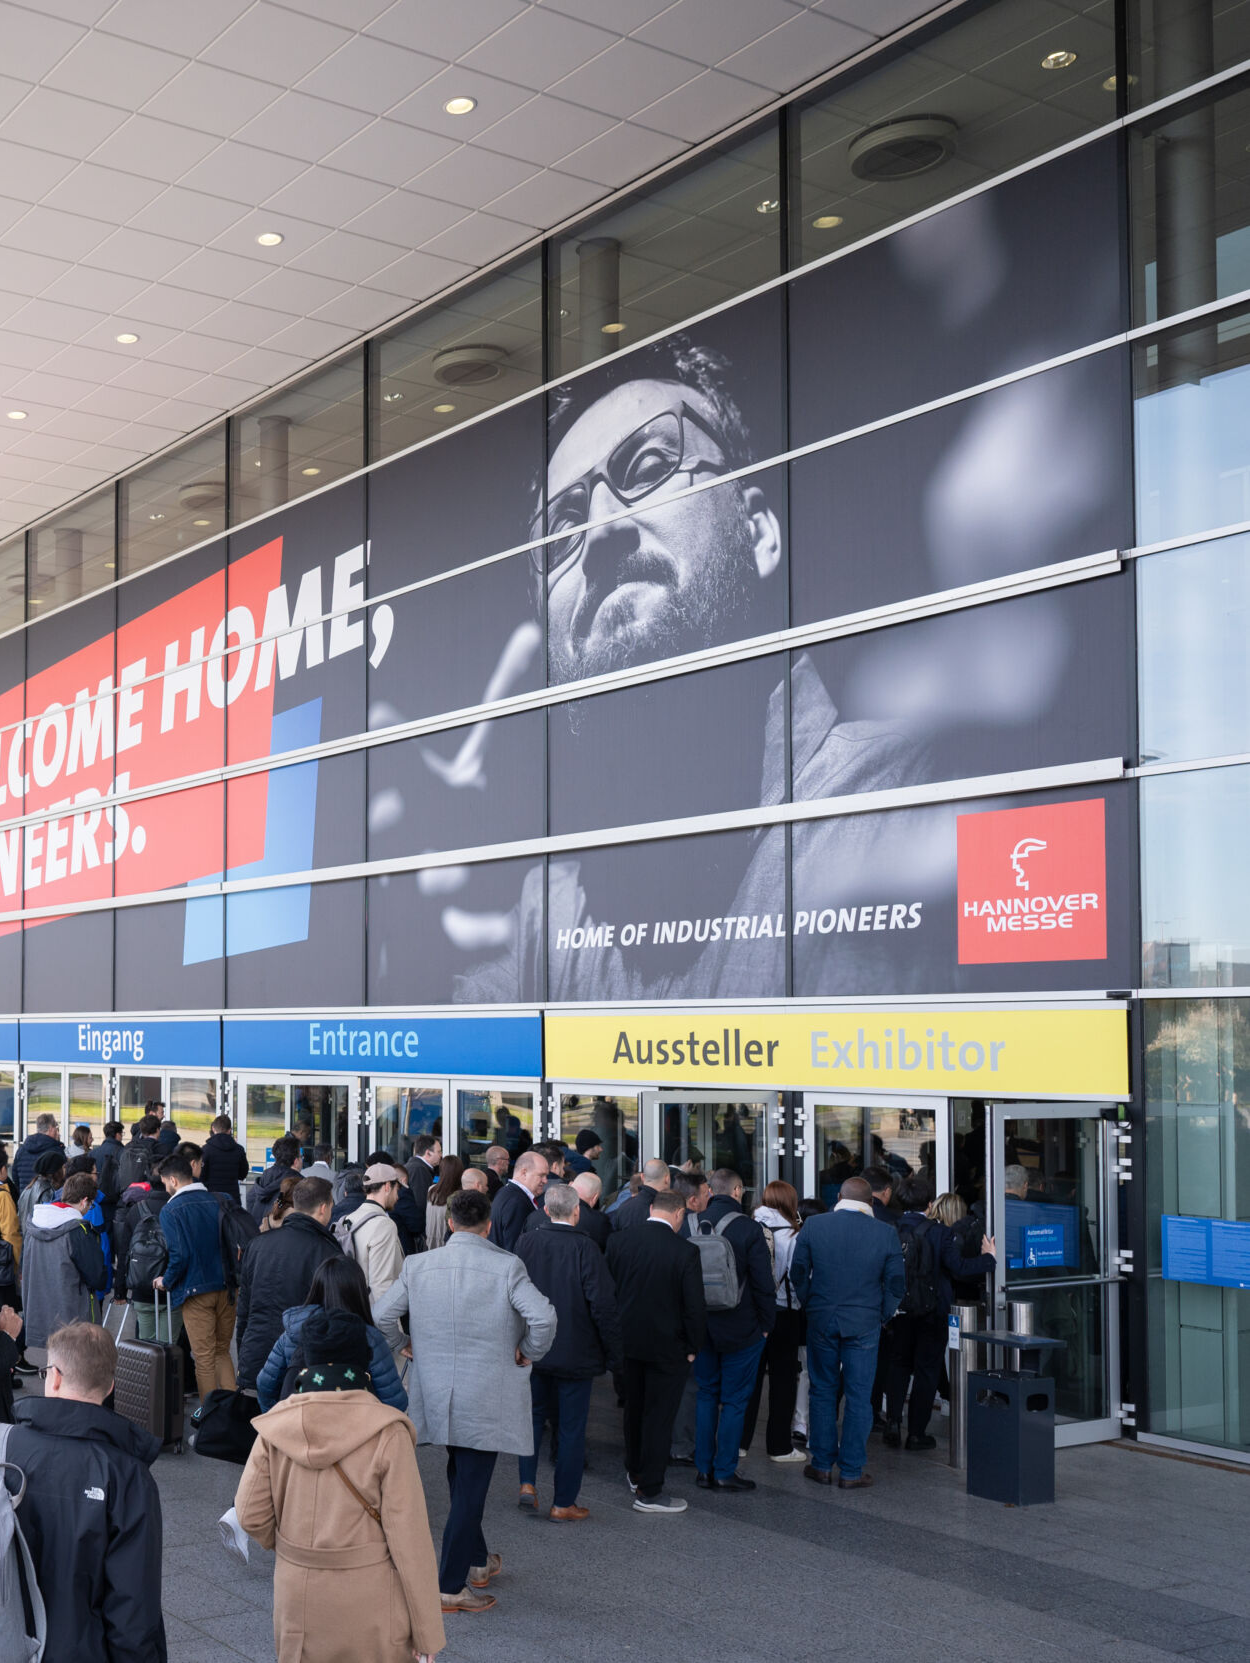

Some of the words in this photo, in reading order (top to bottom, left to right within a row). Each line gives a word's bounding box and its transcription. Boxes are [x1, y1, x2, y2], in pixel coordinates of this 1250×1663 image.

[160, 539, 394, 734] HOME,
[963, 892, 1099, 917] HANNOVER
[987, 911, 1073, 933] MESSE
[555, 925, 615, 950] HOME
[620, 922, 648, 947] OF
[652, 913, 786, 945] INDUSTRIAL
[792, 901, 923, 936] PIONEERS
[77, 1023, 144, 1061] Eingang
[309, 1022, 419, 1058] Entrance
[612, 1028, 780, 1067] Aussteller
[809, 1028, 1006, 1072] Exhibitor
